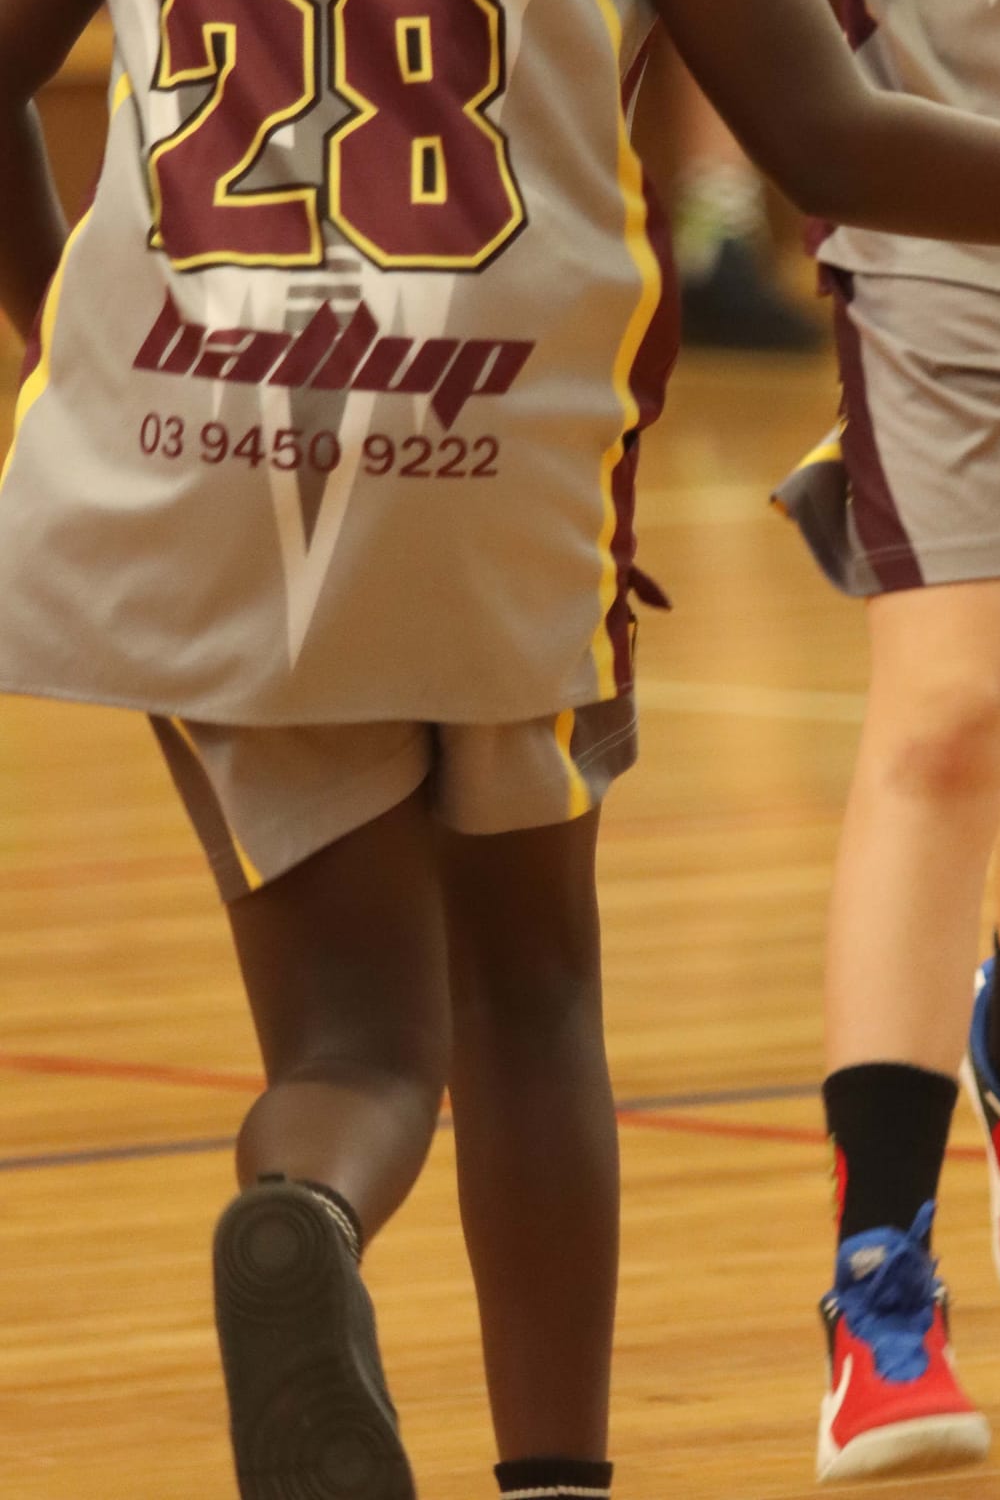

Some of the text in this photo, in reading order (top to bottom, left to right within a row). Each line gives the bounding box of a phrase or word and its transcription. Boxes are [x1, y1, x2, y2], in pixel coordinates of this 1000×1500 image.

[132, 284, 536, 431] ballup
[139, 412, 499, 479] 03 9450 9222
